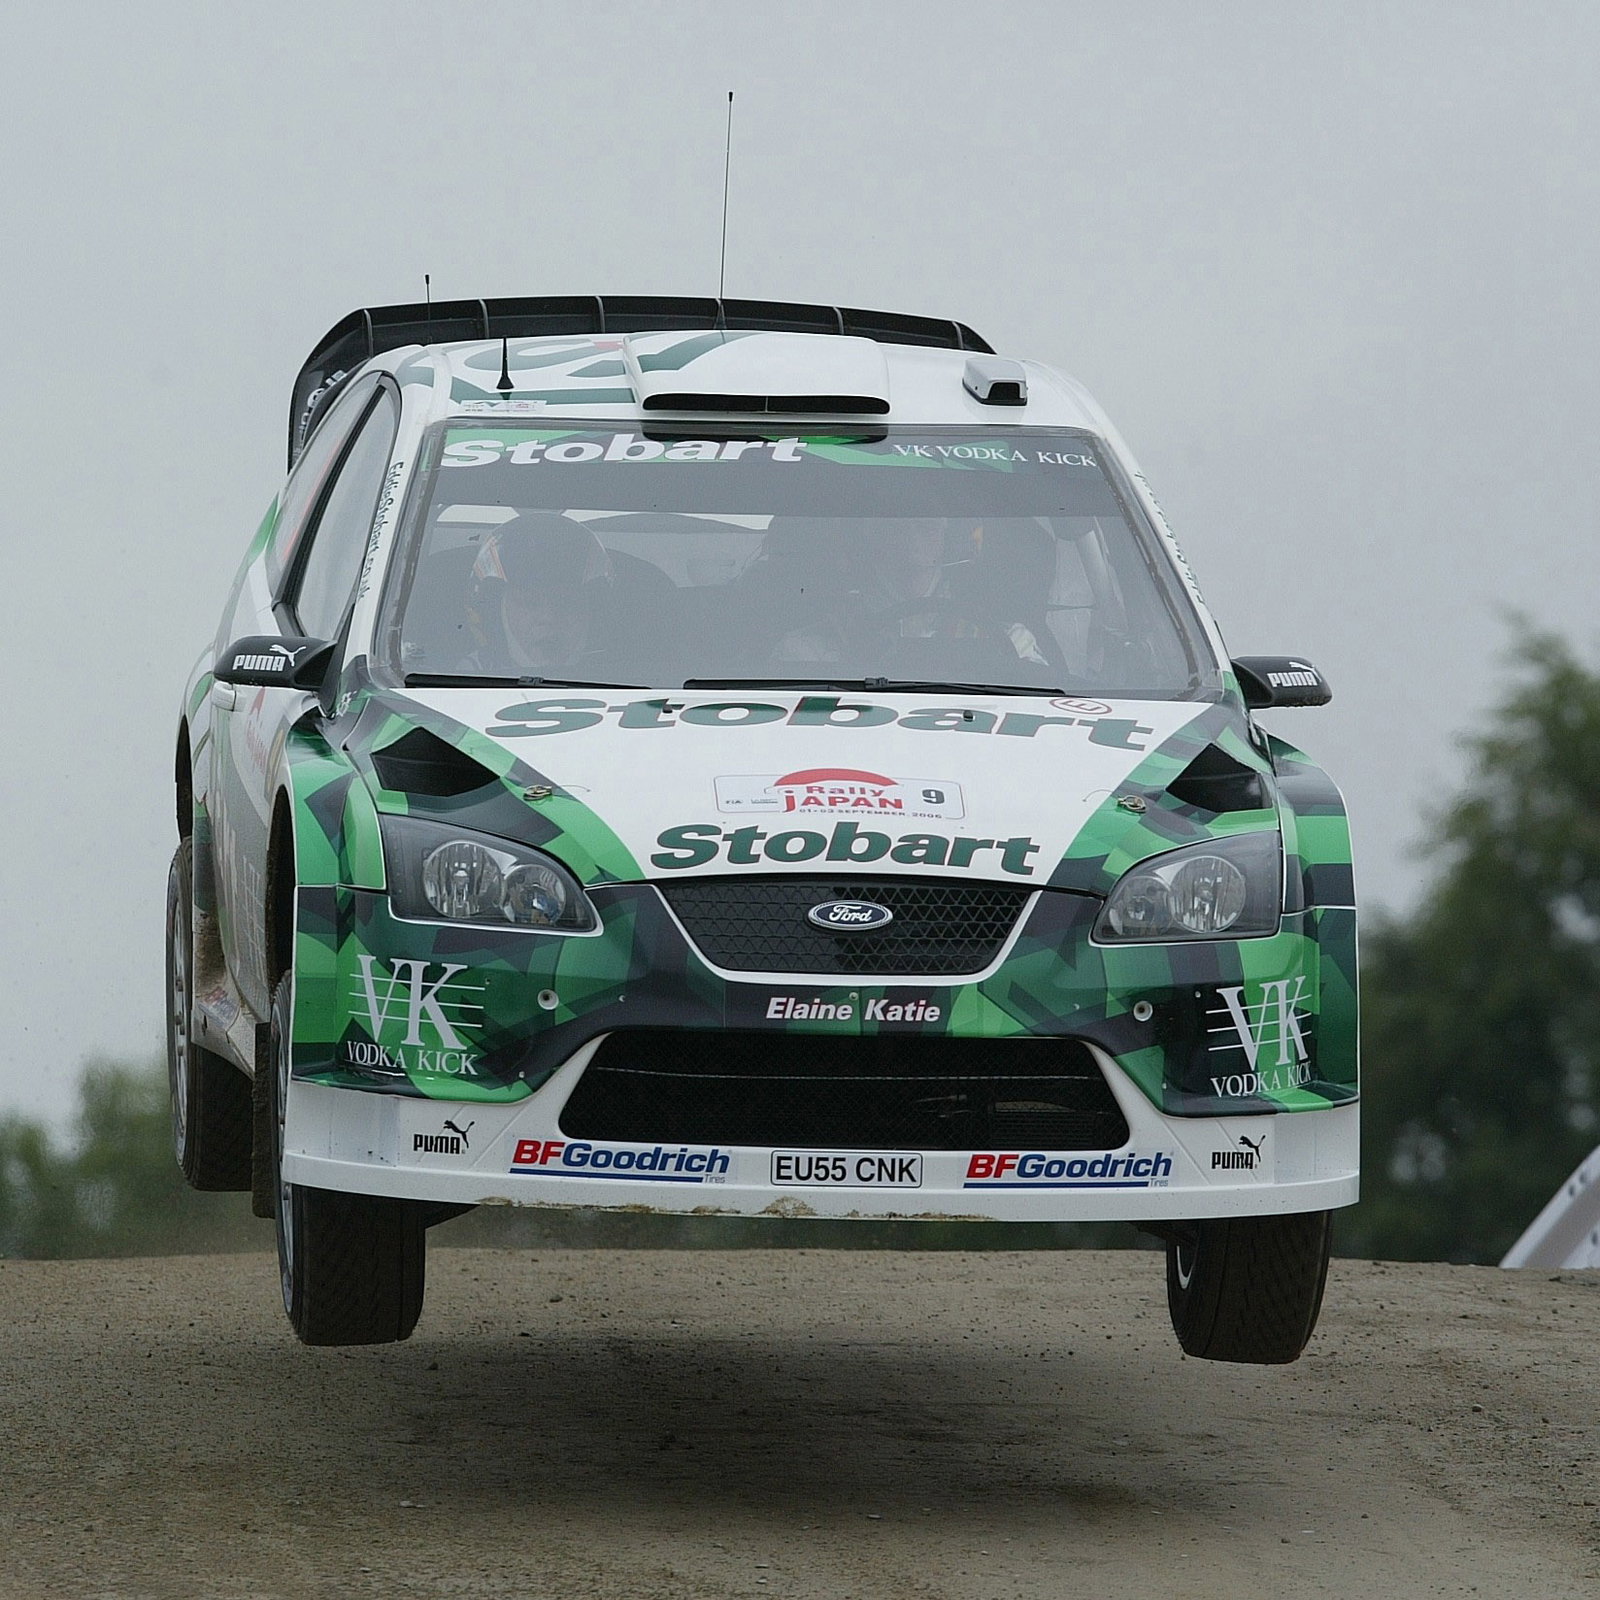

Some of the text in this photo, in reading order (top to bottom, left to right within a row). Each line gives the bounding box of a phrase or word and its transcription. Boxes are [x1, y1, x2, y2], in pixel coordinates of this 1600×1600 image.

[441, 433, 806, 468] Stobart
[893, 444, 1097, 467] VK VODKA KICK
[232, 654, 286, 672] PUMA
[1267, 671, 1318, 688] PUMA
[485, 697, 1153, 752] Stobart
[806, 786, 884, 797] Rally
[922, 789, 945, 804] 9
[650, 821, 1041, 876] Stobart
[828, 904, 873, 924] Ford
[357, 954, 468, 1050] VK
[766, 997, 941, 1022] Elaine Katie
[1216, 975, 1308, 1072] VK
[347, 1040, 479, 1076] VODKA KICK
[1210, 1060, 1312, 1098] VODKA KICK
[413, 1134, 461, 1155] PUMA
[512, 1139, 730, 1174] BFGoodrich
[776, 1156, 917, 1183] EU55 CNK
[966, 1152, 1173, 1179] BFGoodrich
[1211, 1151, 1254, 1170] PUMA
[704, 1174, 726, 1185] Tires
[1150, 1178, 1169, 1188] Tires
